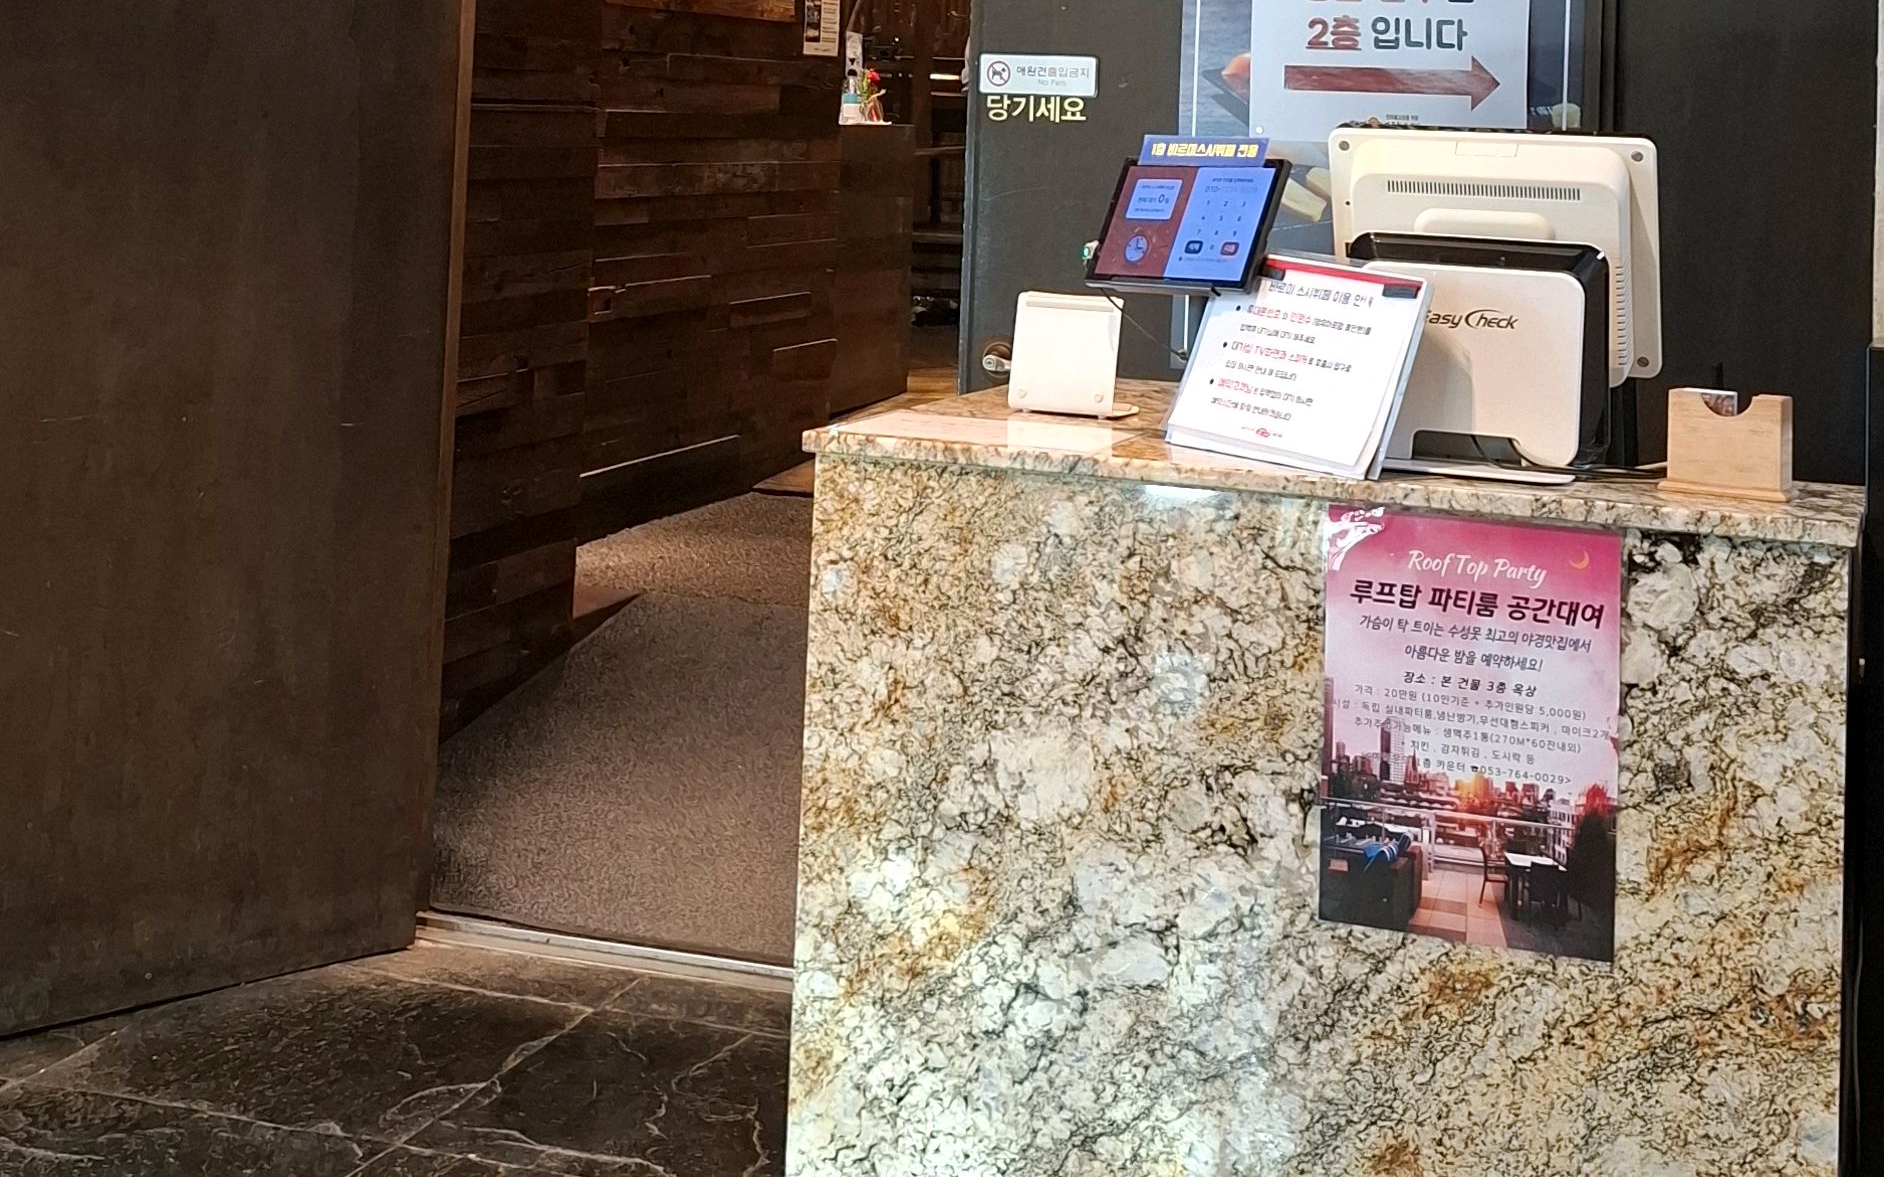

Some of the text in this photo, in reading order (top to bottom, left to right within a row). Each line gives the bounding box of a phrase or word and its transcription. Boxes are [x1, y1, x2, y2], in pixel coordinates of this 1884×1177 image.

[1306, 15, 1468, 51] 2층 입니다
[987, 94, 1086, 123] 당기세요
[1408, 550, 1547, 590] Roof Top Party
[1350, 578, 1605, 630] 루프탑 파티룸 공간대여
[1360, 614, 1592, 653] 가슴이 탁 트이는 수성못 최고의 야경맛집에서
[1404, 645, 1544, 672] 아름다운 밤을 예약하세요!
[1355, 685, 1373, 695] 가격
[1384, 688, 1417, 701] 20만원
[1403, 672, 1426, 685] 장소
[1441, 676, 1452, 688] 본
[1458, 679, 1481, 692] 건물
[1486, 681, 1506, 694] 3층
[1512, 684, 1537, 698] 옥상
[1362, 702, 1380, 713] 독립
[1436, 760, 1465, 772] 카운터
[1441, 744, 1480, 758] 감자튀김
[1492, 750, 1521, 762] 도시락
[1526, 754, 1535, 765] 등
